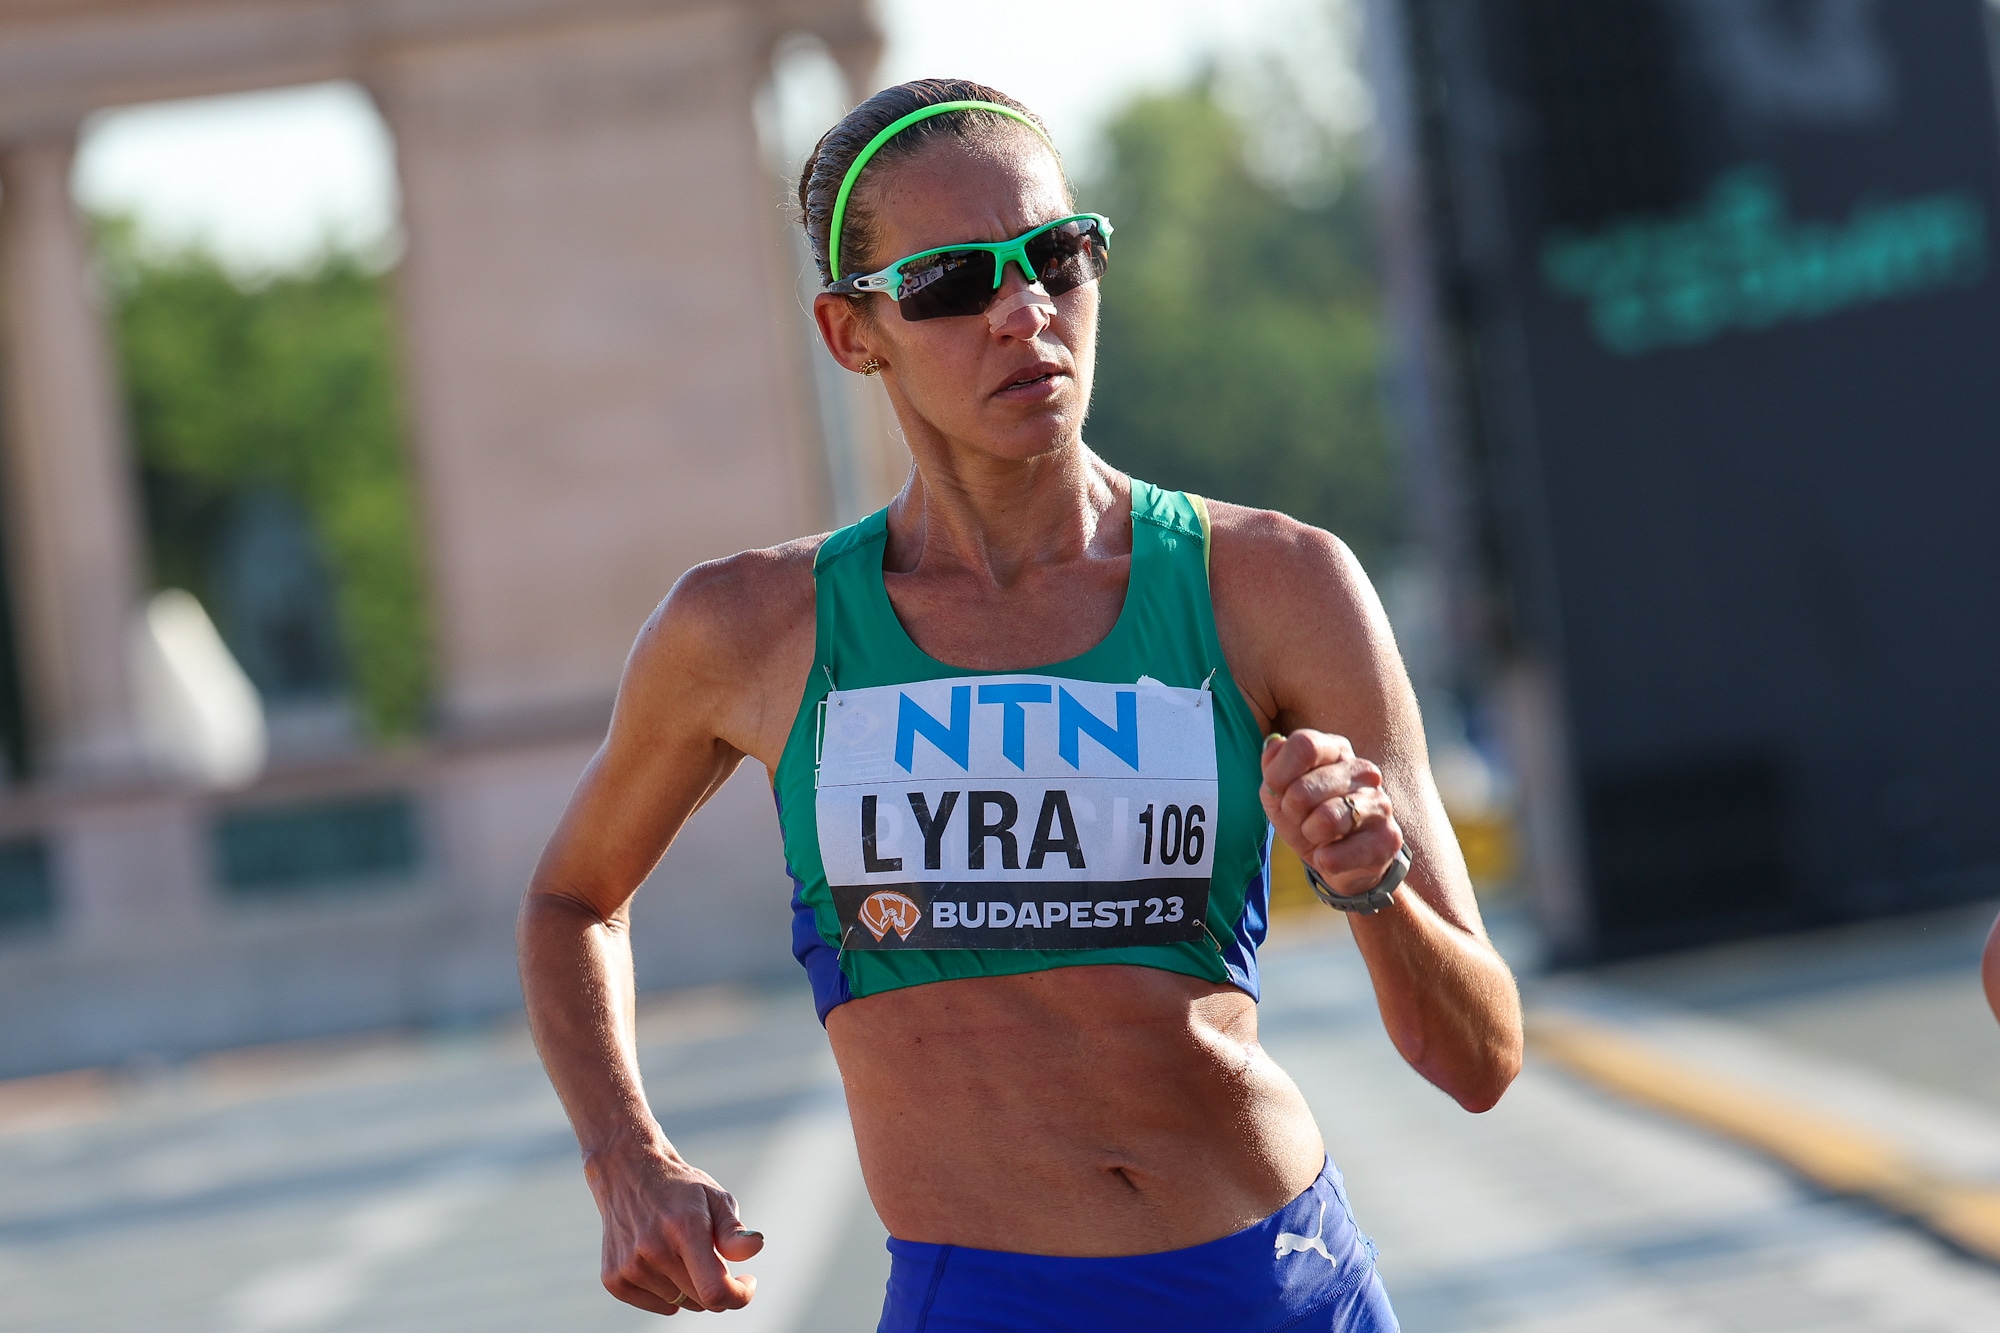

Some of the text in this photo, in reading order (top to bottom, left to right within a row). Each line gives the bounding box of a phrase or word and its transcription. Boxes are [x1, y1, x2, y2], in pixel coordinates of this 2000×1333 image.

[895, 685, 1139, 773] NTN
[861, 790, 1206, 873] LYRA 106
[932, 896, 1184, 929] BUDAPEST 23
